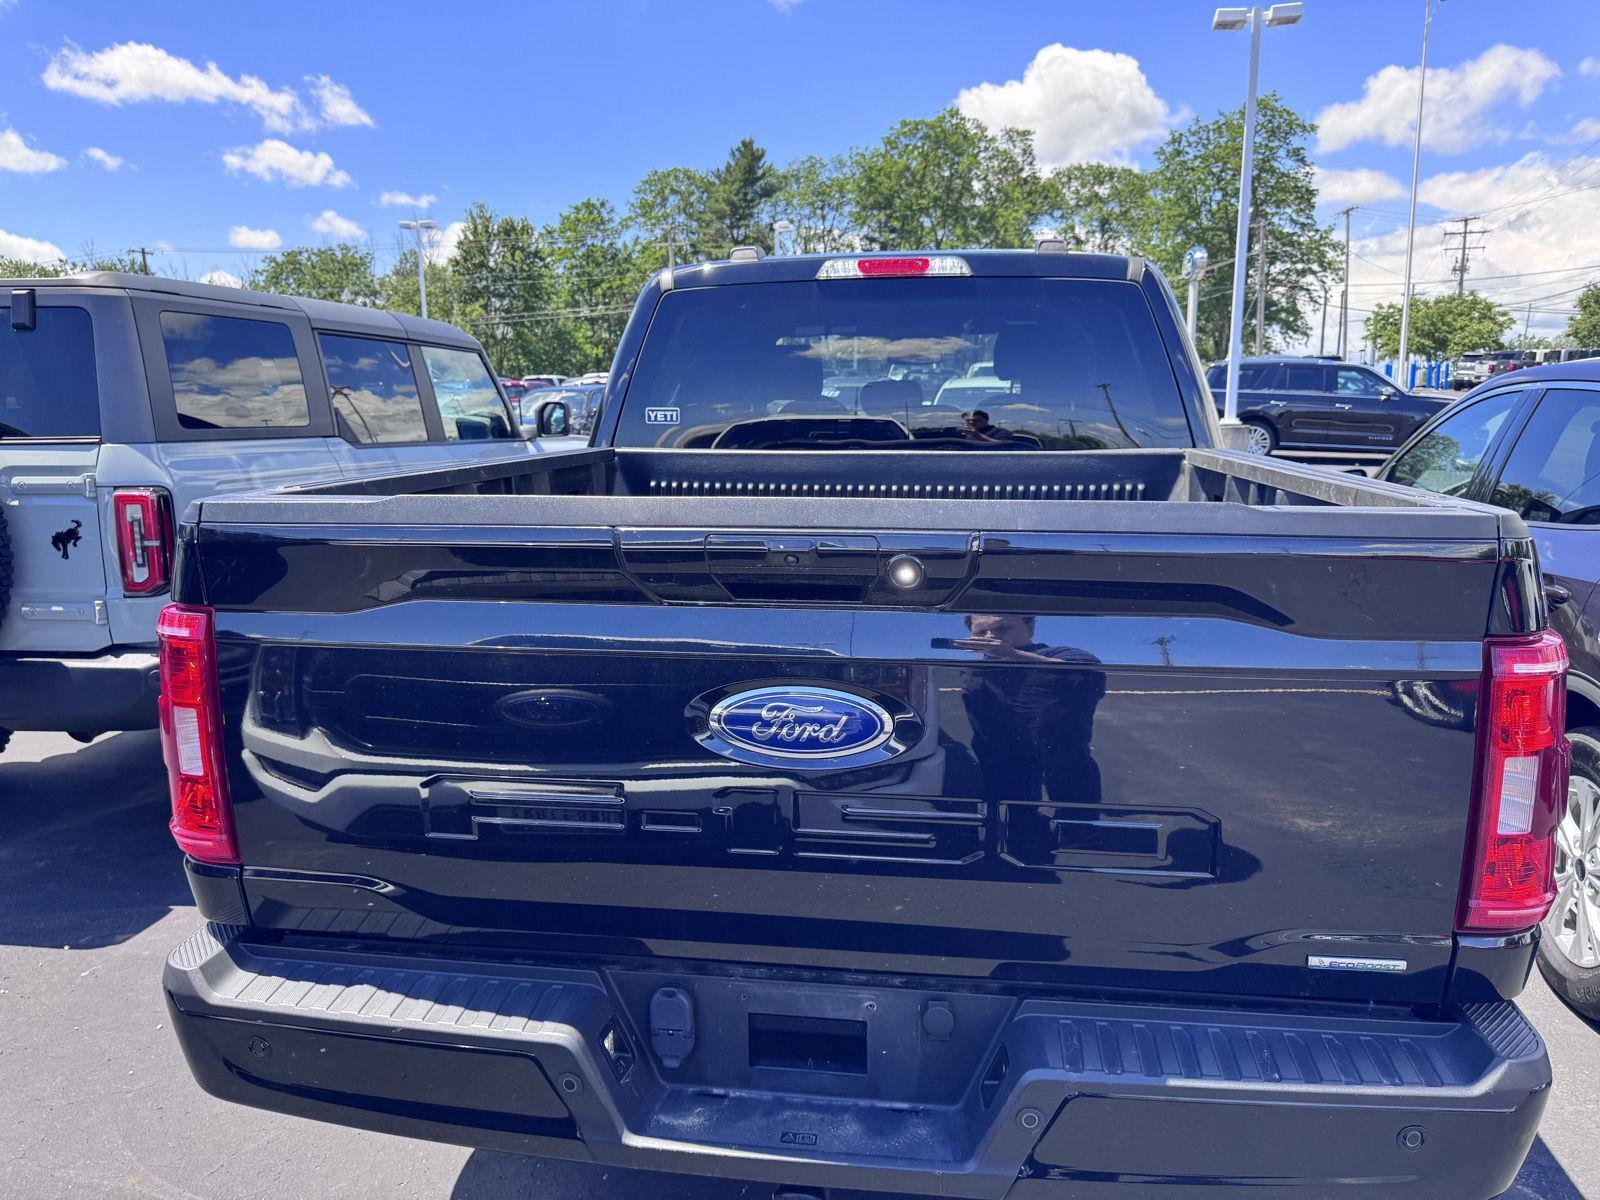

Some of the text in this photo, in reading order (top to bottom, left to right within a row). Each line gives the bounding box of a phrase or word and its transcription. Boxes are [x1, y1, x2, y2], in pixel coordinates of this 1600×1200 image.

[648, 411, 677, 421] YETI
[752, 702, 848, 743] Ford
[421, 773, 1221, 878] F-150
